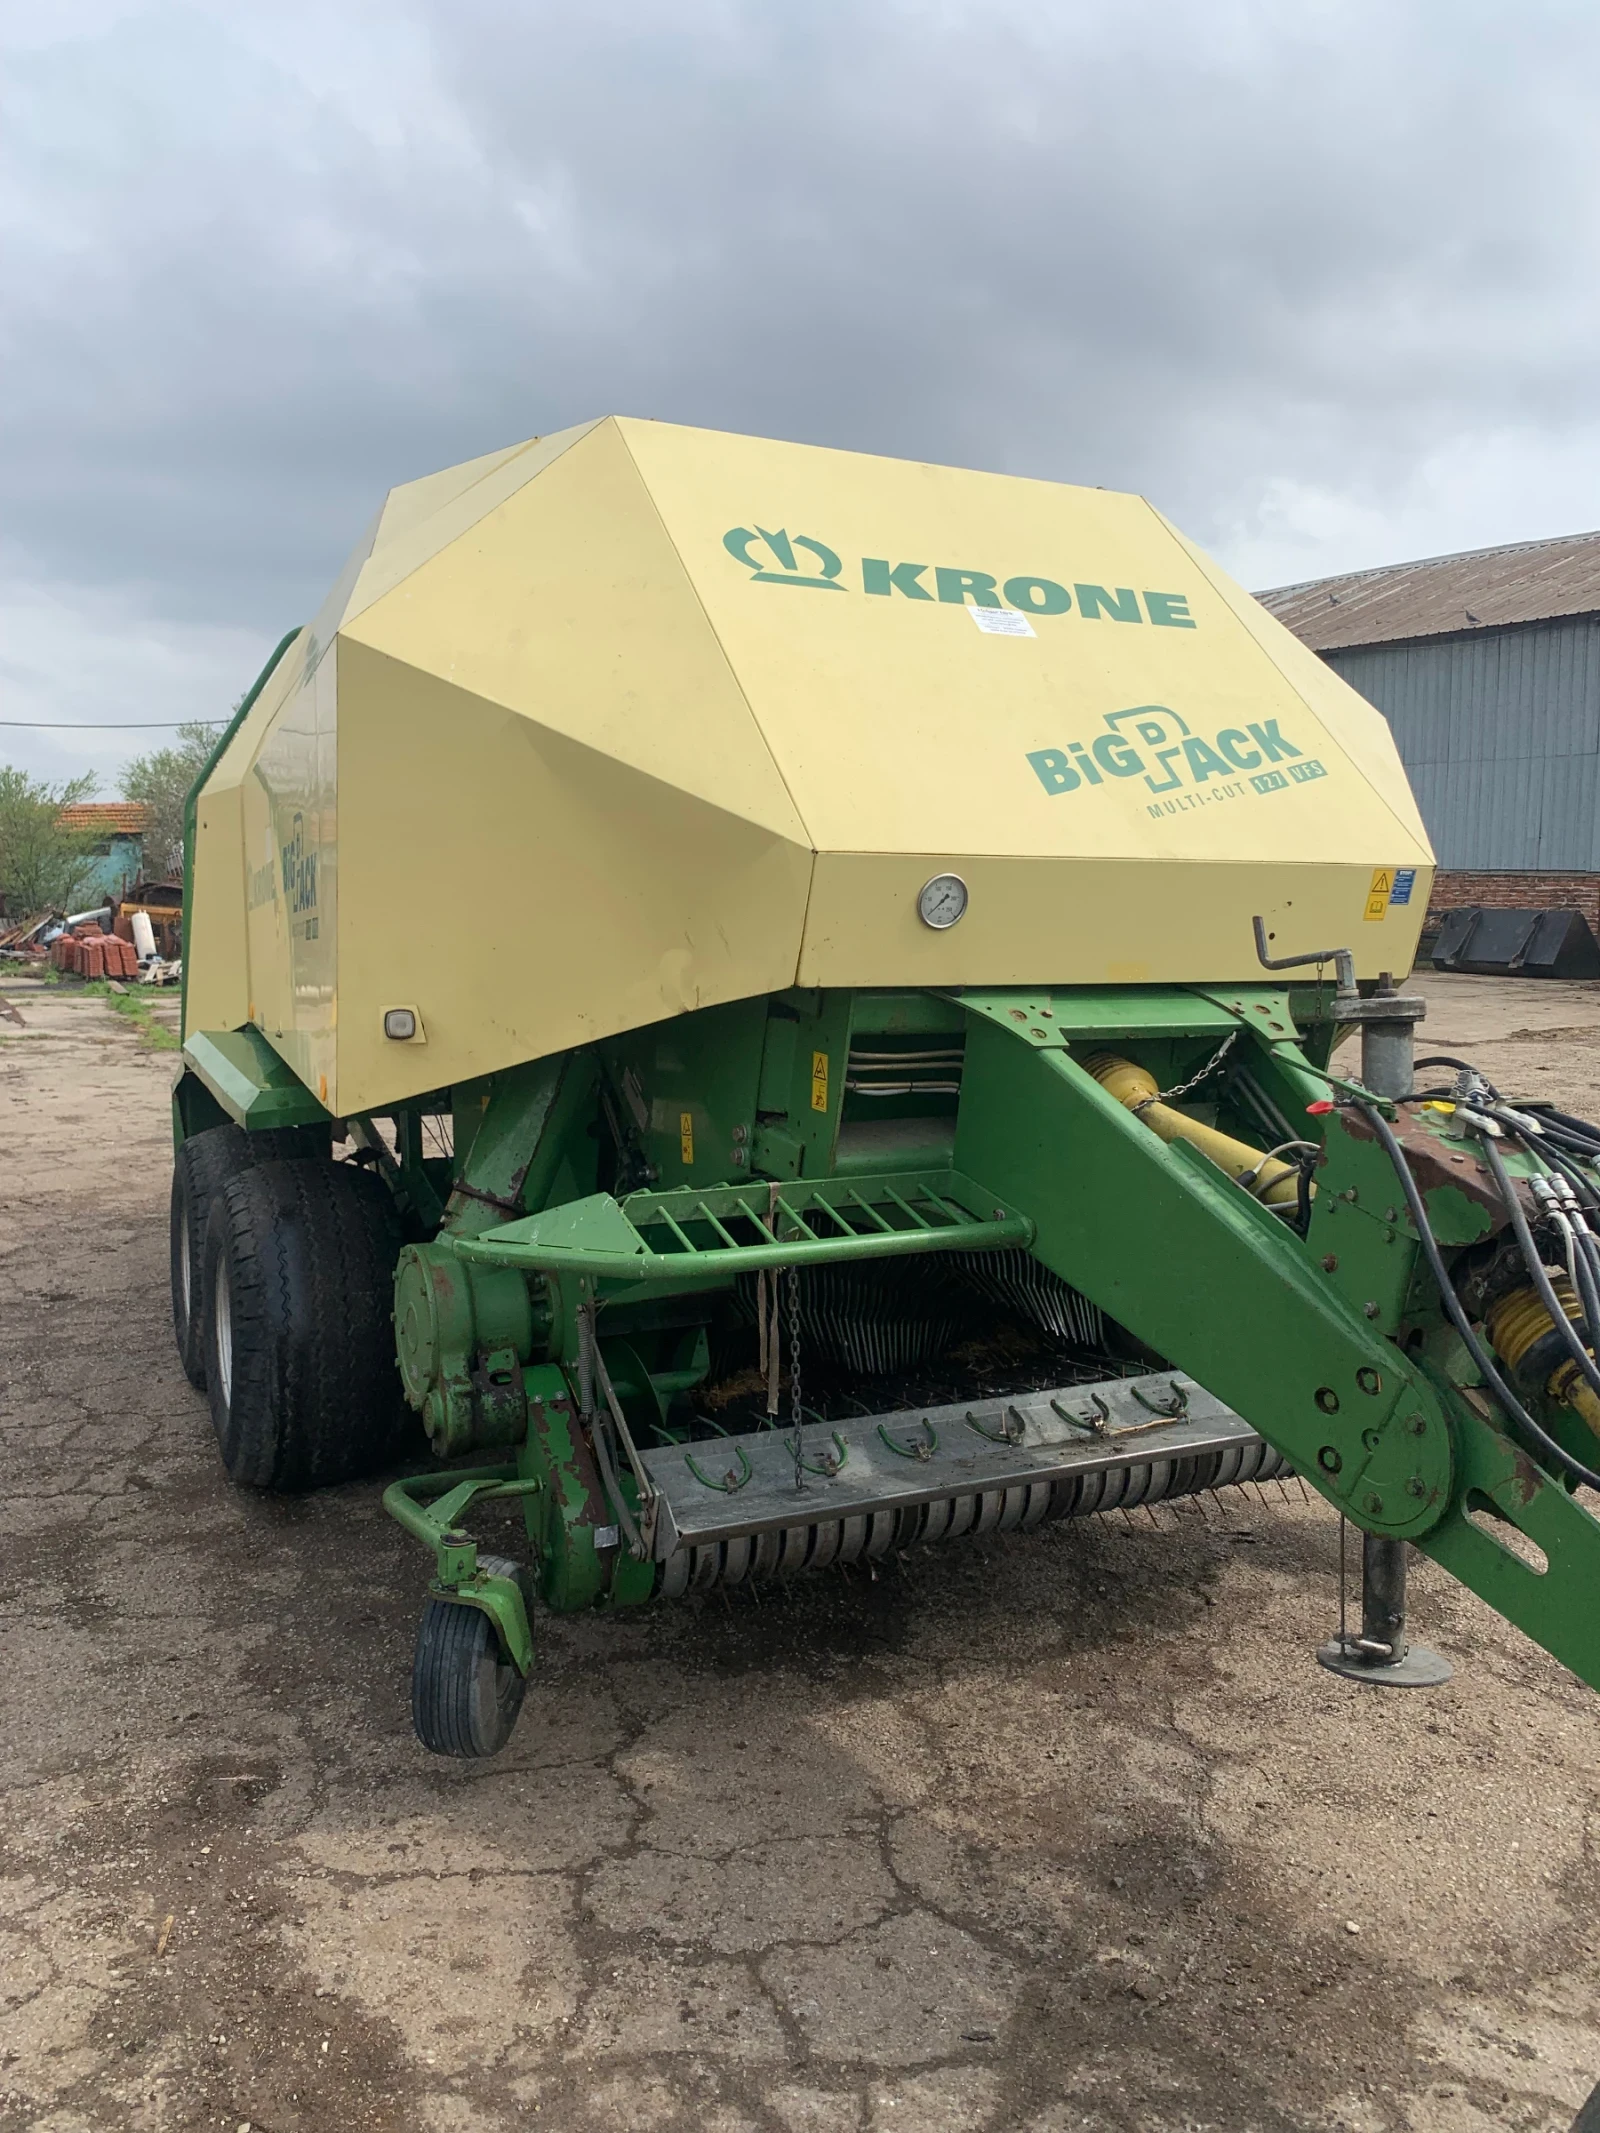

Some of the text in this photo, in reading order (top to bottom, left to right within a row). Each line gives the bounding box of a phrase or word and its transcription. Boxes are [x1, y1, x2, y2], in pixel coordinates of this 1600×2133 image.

[861, 557, 1198, 630] KRONE
[1146, 762, 1324, 819] MULTI-CUT 127 VFS
